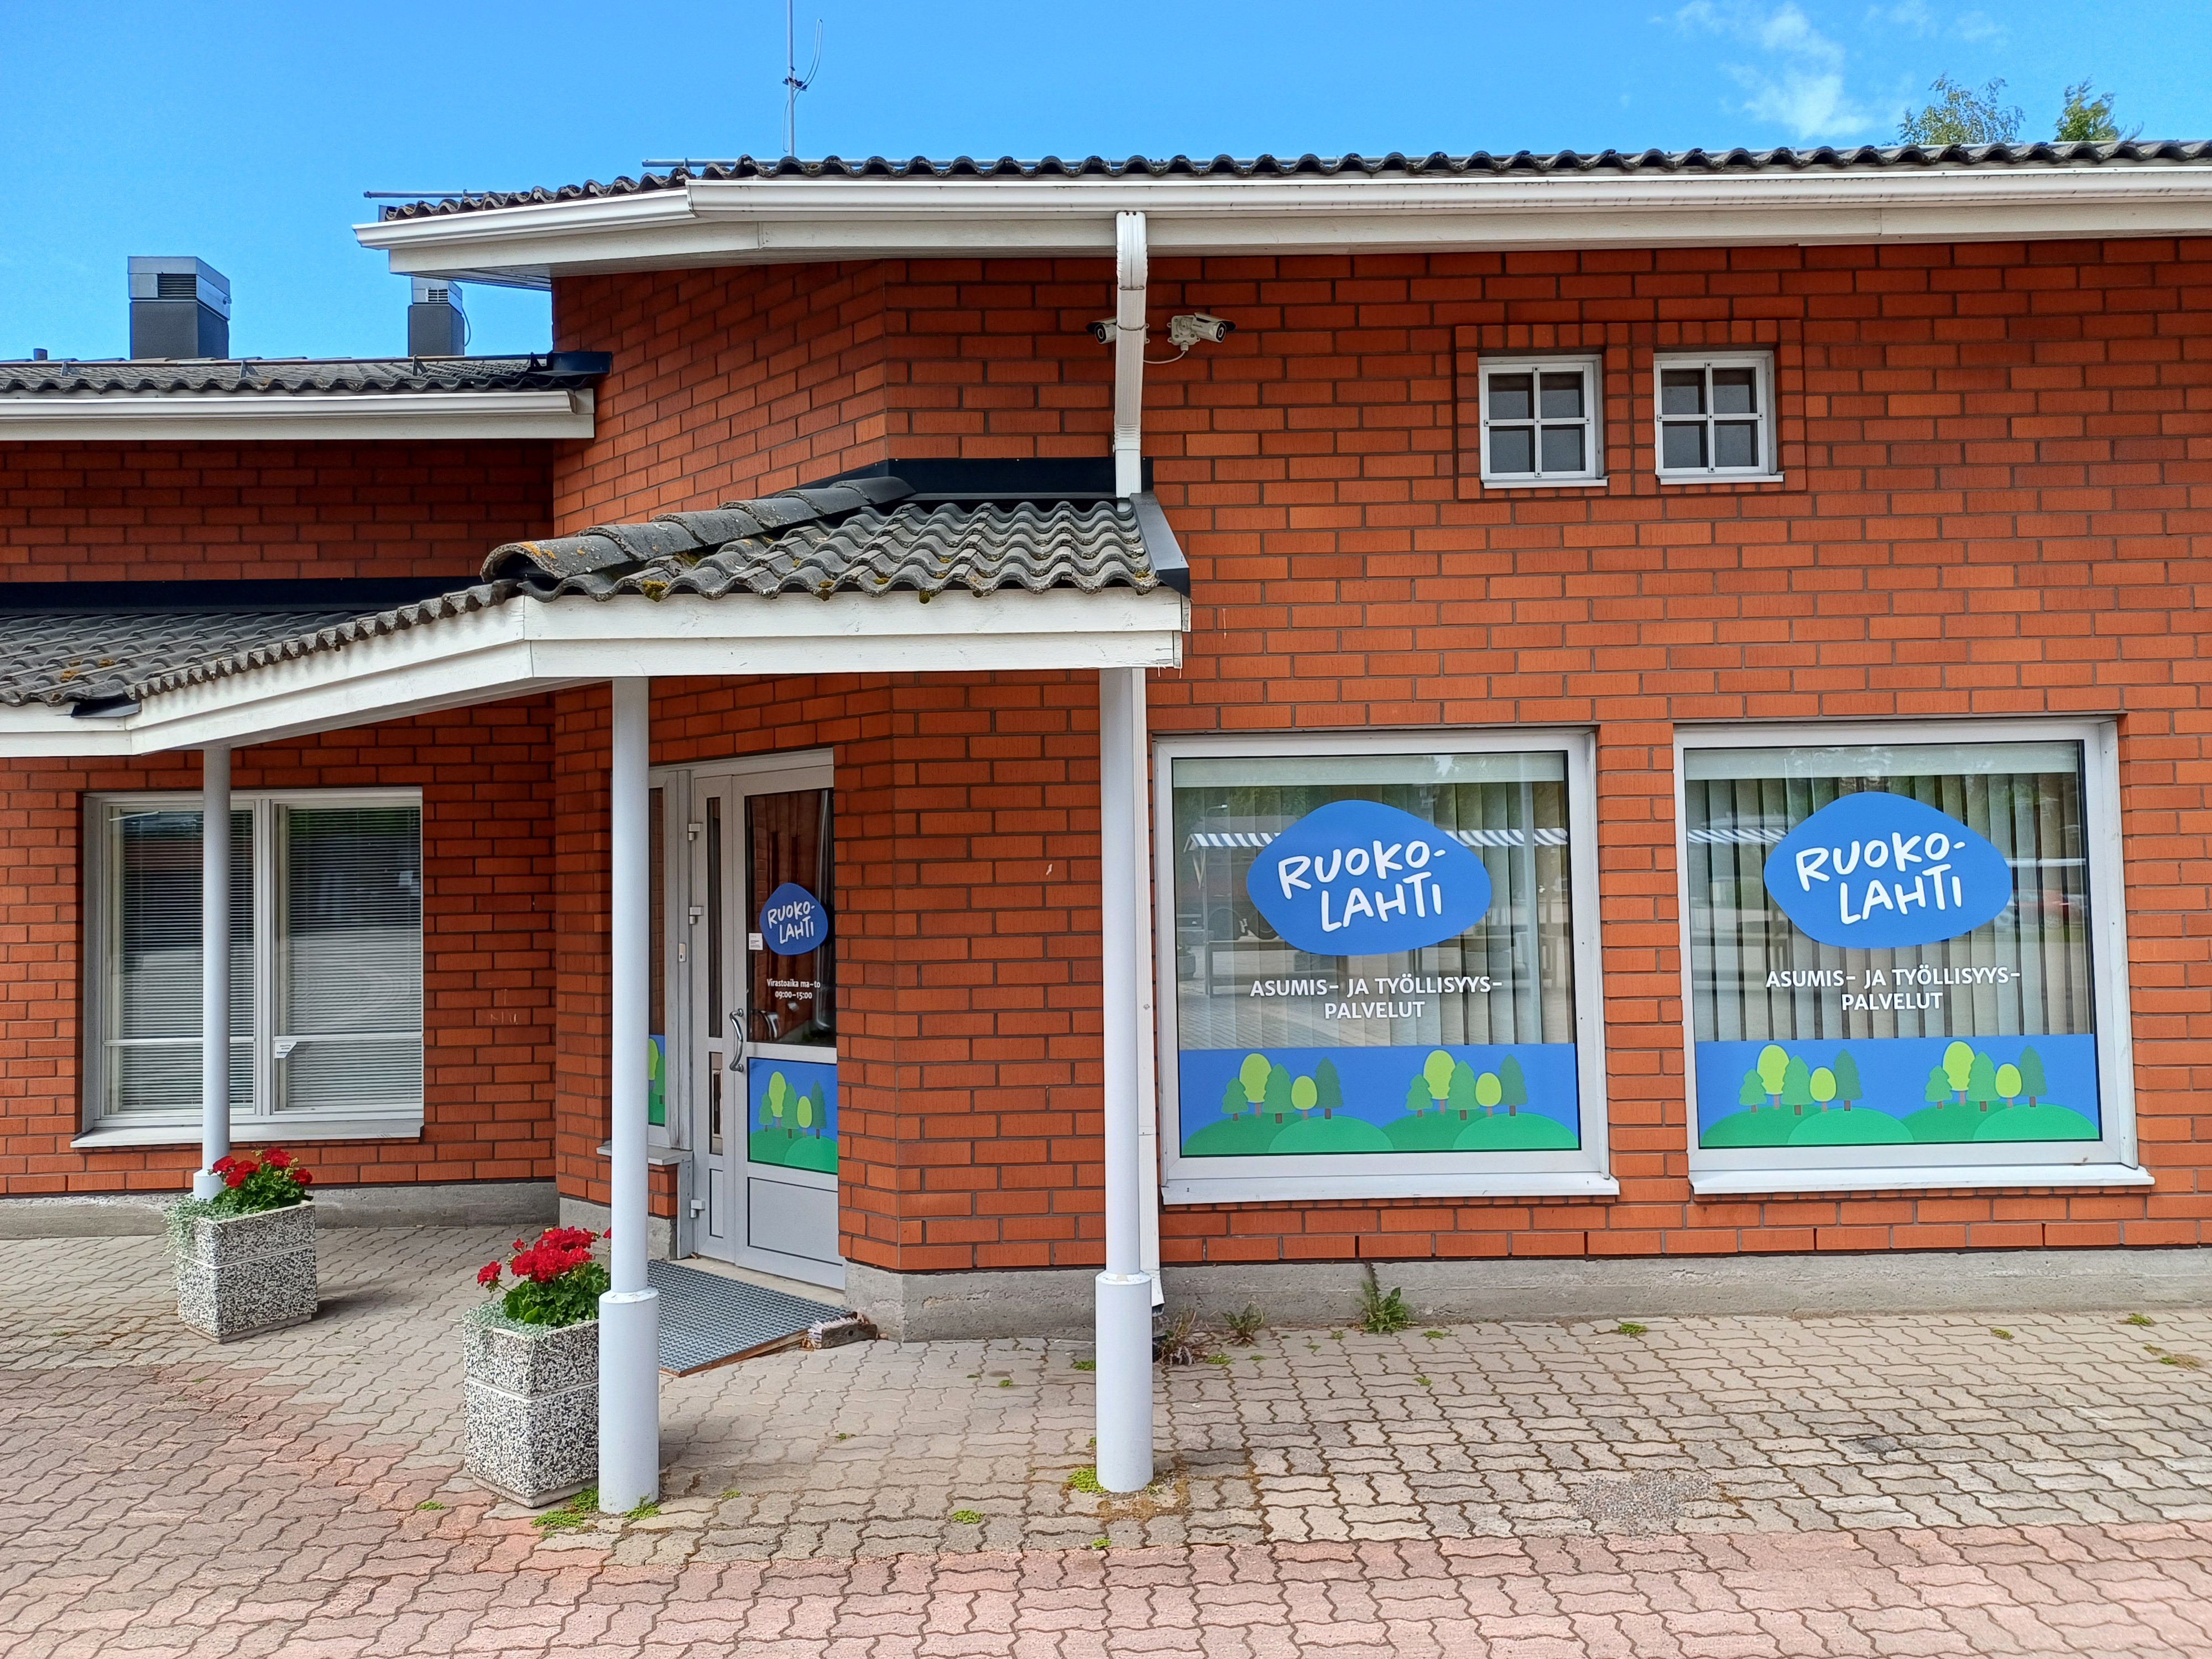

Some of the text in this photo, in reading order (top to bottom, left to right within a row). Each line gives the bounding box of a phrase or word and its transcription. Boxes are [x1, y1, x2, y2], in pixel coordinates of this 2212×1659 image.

[1278, 840, 1446, 899] RUOKO-
[1796, 832, 1965, 891] RUOKO-
[1321, 872, 1442, 932] LAHTI
[1840, 864, 1961, 924] LAHTI
[767, 901, 815, 929] RUOKO-
[779, 916, 814, 944] LAHTI
[766, 978, 799, 987] Virastoaika
[1250, 973, 1503, 998] ASUMIS- JA TYÖLLISYYS-
[1765, 964, 2020, 989] ASUMIS- JA TYÖLLISYYS-
[1325, 1001, 1425, 1019] PALVELUT
[1841, 993, 1943, 1010] PALVELUT
